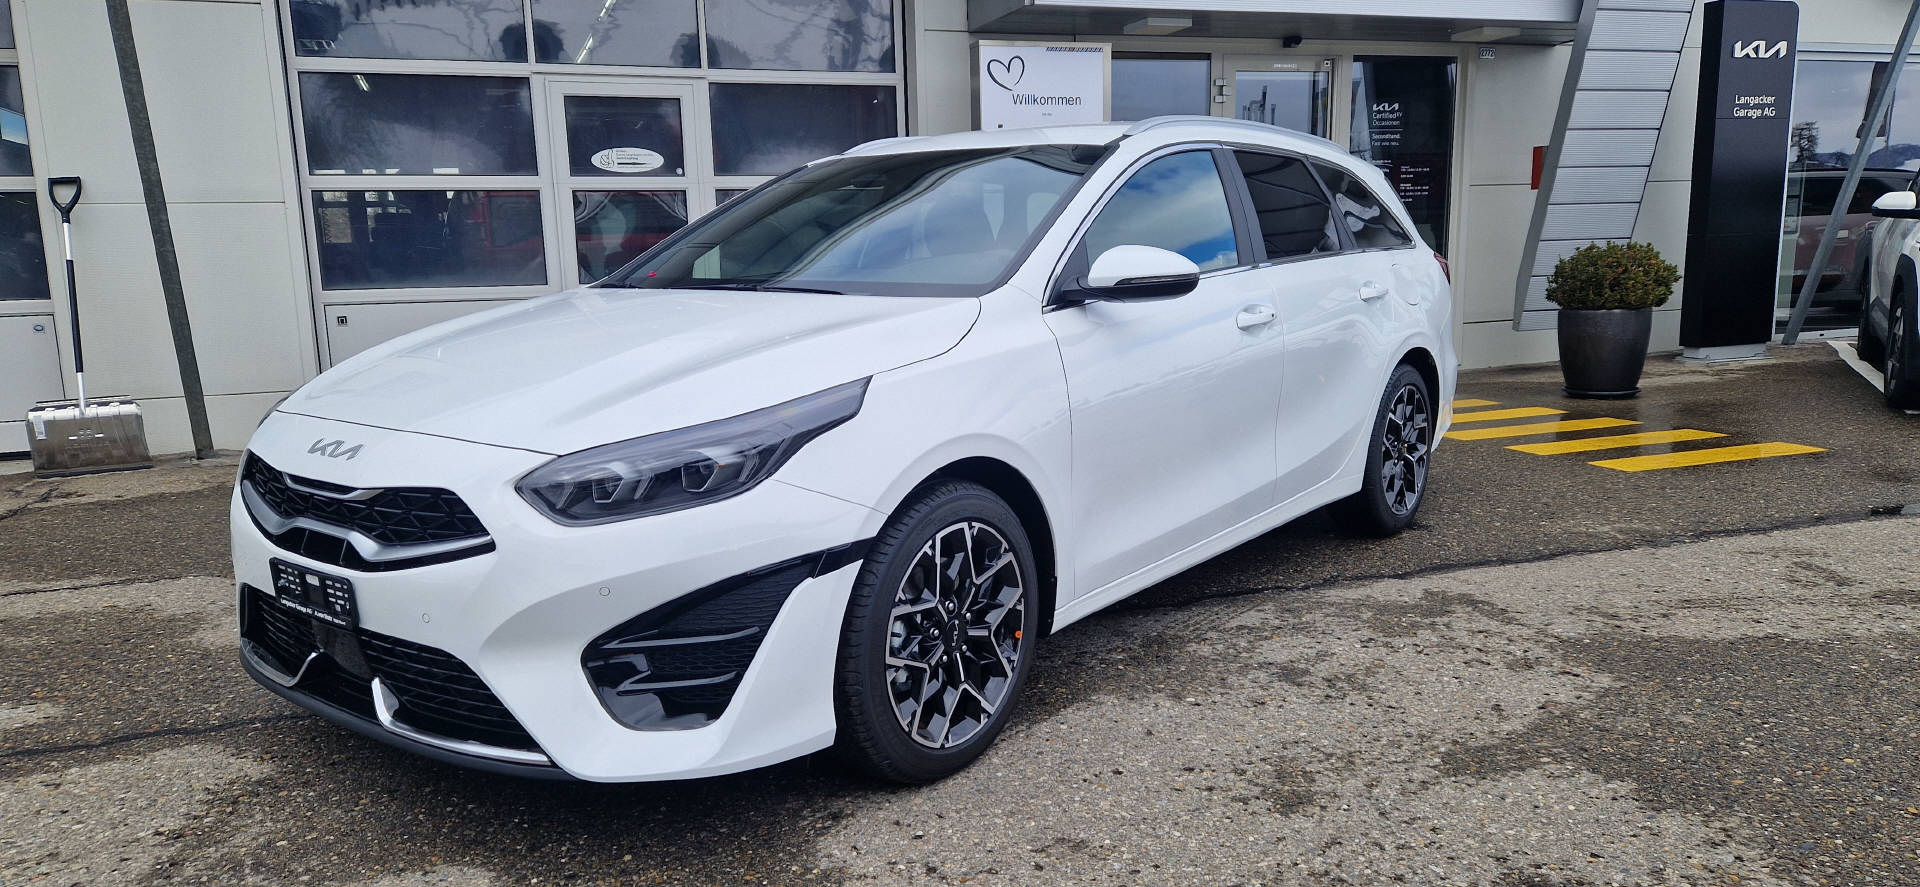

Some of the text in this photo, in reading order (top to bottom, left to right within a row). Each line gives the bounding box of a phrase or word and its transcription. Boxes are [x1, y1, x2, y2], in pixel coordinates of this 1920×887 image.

[1734, 40, 1787, 58] KIA
[1012, 93, 1082, 106] Willkommen
[1735, 94, 1776, 106] Langacker
[1372, 102, 1399, 111] KIA
[1733, 107, 1776, 119] Garage AG
[307, 438, 364, 461] KIA
